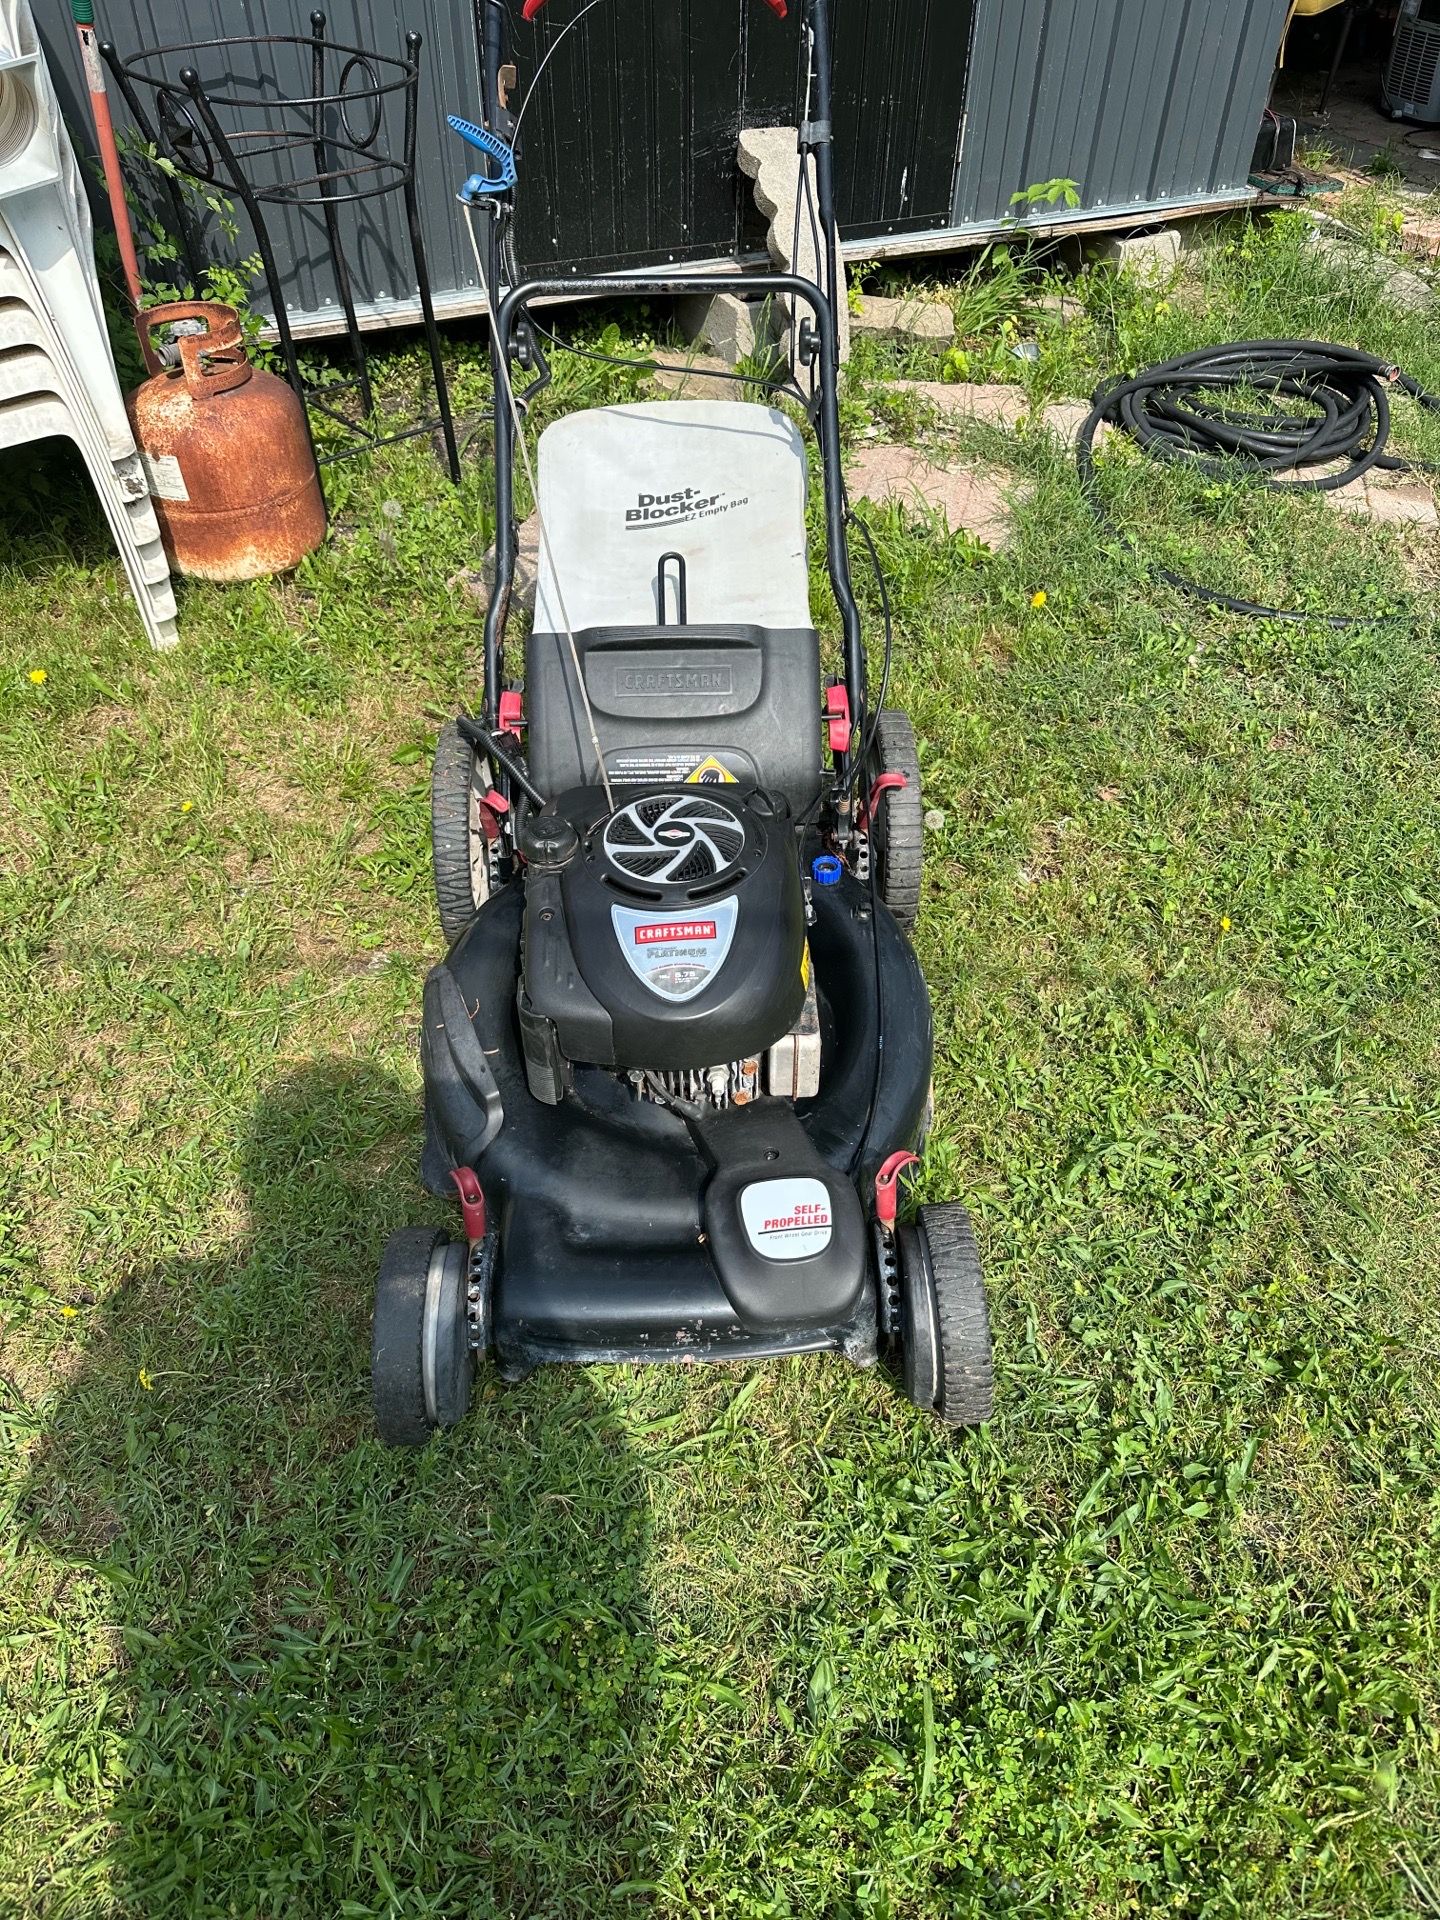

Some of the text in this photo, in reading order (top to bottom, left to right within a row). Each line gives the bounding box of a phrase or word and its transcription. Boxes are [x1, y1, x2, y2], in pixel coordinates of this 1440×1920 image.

[638, 487, 701, 508] Dust-
[625, 493, 720, 522] Blocker
[684, 497, 749, 522] EZ Empty Bag
[625, 672, 722, 690] CRAFTSMAN
[639, 925, 713, 940] CRAFTSMAN
[794, 1203, 826, 1215] SELF-
[763, 1214, 828, 1230] PROPELLED
